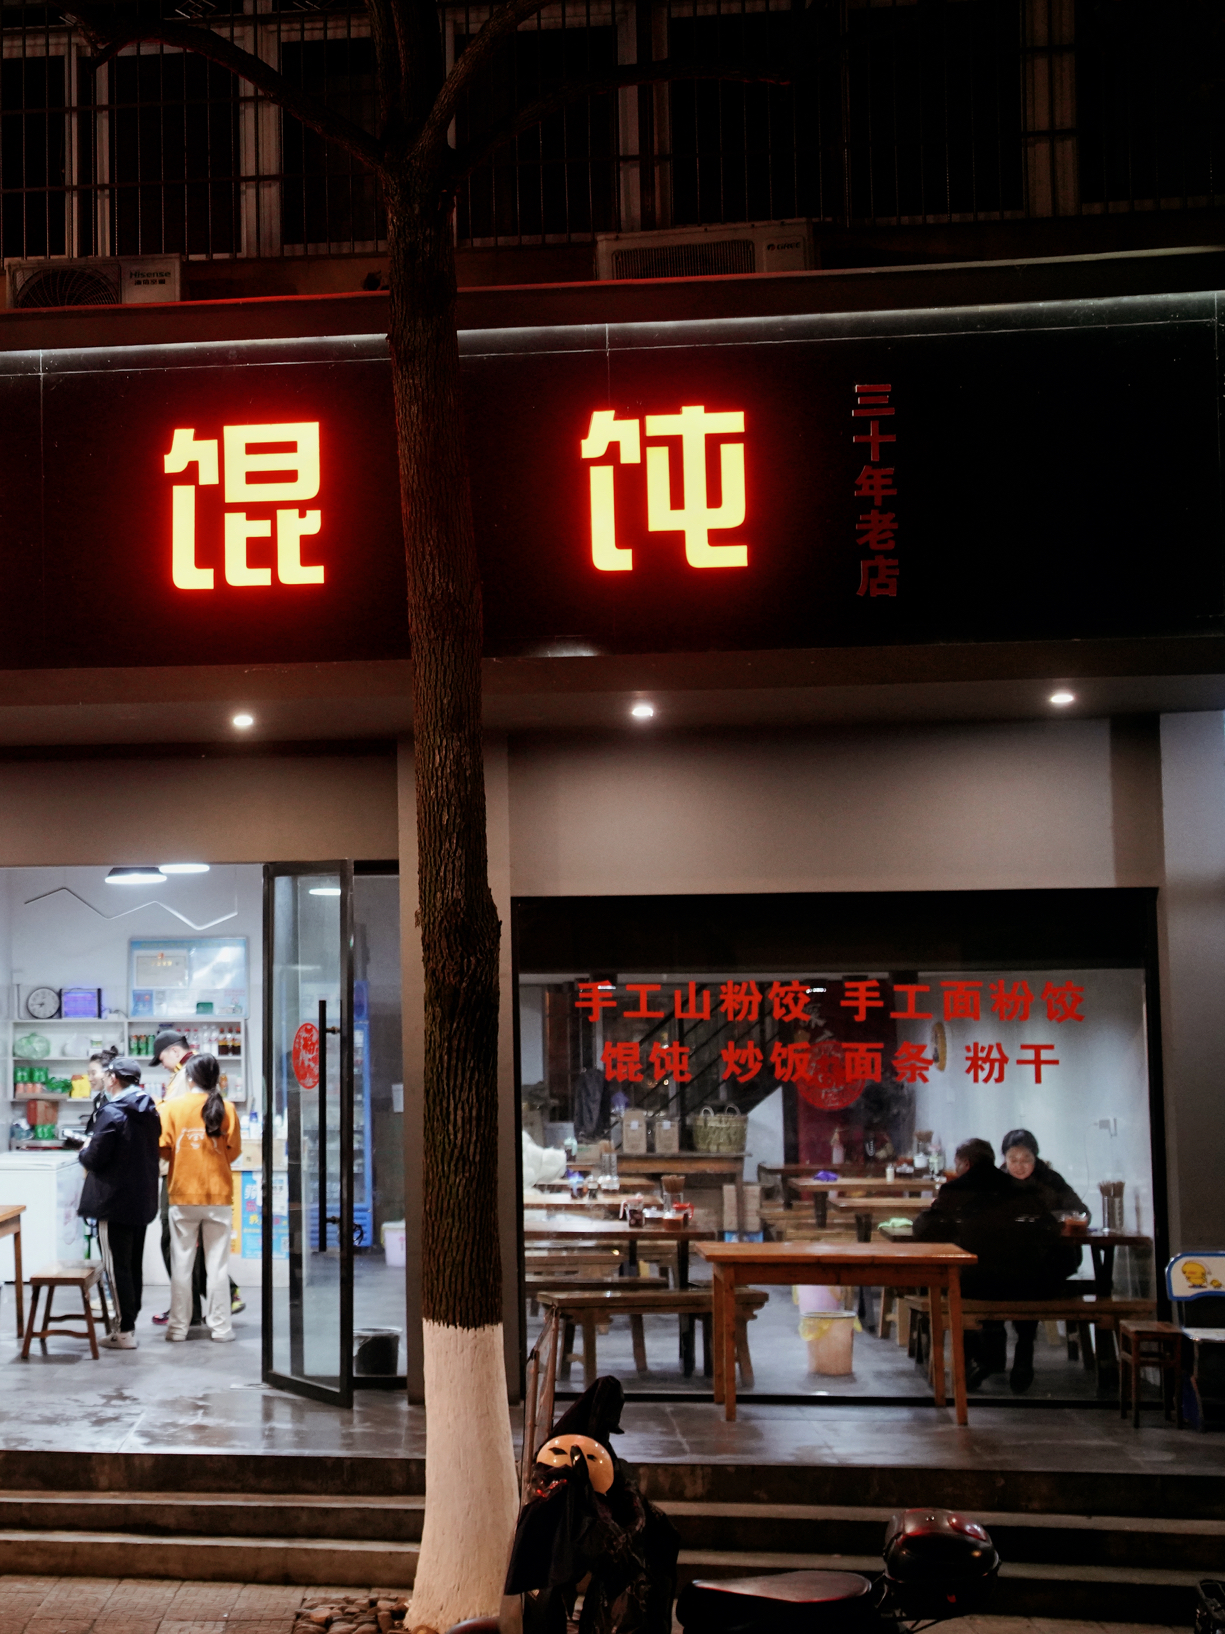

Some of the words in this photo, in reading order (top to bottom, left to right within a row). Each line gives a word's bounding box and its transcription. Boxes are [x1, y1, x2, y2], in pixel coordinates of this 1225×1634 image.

[129, 270, 171, 278] Hisense
[851, 383, 900, 598] 三十年老店
[575, 979, 811, 1022] 手工山粉饺
[840, 979, 1085, 1023] 手工面粉饺
[601, 1041, 692, 1083] 馄饨
[721, 1040, 813, 1083] 炒饭
[841, 1041, 934, 1083] 面条
[964, 1041, 1060, 1084] 粉干
